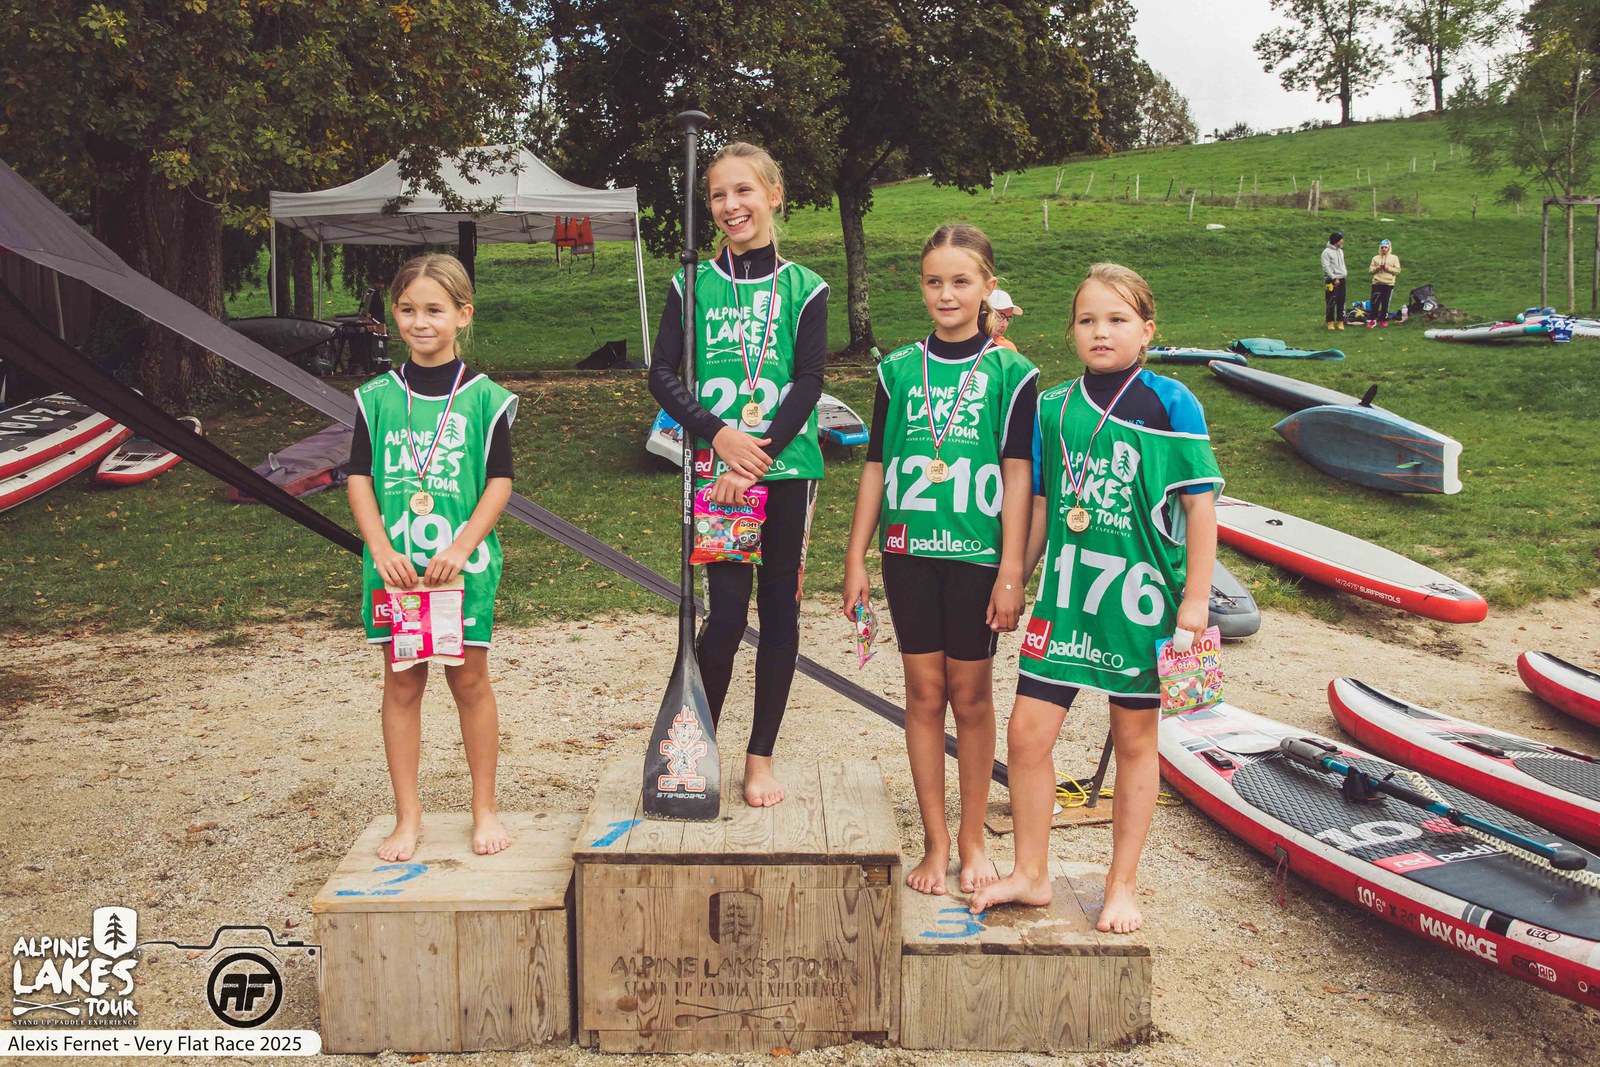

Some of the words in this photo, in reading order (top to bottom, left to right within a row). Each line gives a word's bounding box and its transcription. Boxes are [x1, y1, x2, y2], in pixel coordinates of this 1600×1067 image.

[706, 306, 752, 321] ALPINE
[706, 320, 779, 347] LAKES
[746, 344, 779, 361] TOR
[696, 377, 808, 435] 22
[385, 429, 435, 446] ALPNE
[949, 425, 980, 440] TOUR
[695, 449, 714, 472] ed
[1061, 451, 1110, 476] LPNE
[426, 475, 460, 492] TOUR
[684, 448, 692, 525] STARBOARD
[884, 455, 1003, 517] 1210
[1095, 508, 1133, 531] TOUR
[886, 524, 906, 549] red
[1359, 585, 1401, 604] SURFPISTOLS
[375, 603, 390, 617] re
[1021, 620, 1051, 650] red
[656, 792, 707, 800] STARBOARD
[1393, 852, 1434, 869] red
[335, 863, 428, 897] 2
[919, 907, 988, 938] 3
[1419, 913, 1454, 945] MAX
[1455, 929, 1499, 965] RACE
[611, 956, 698, 978] ALPINE
[704, 957, 783, 979] LAKES
[786, 956, 861, 985] TOUR
[624, 981, 668, 997] STAND
[675, 981, 694, 997] UP
